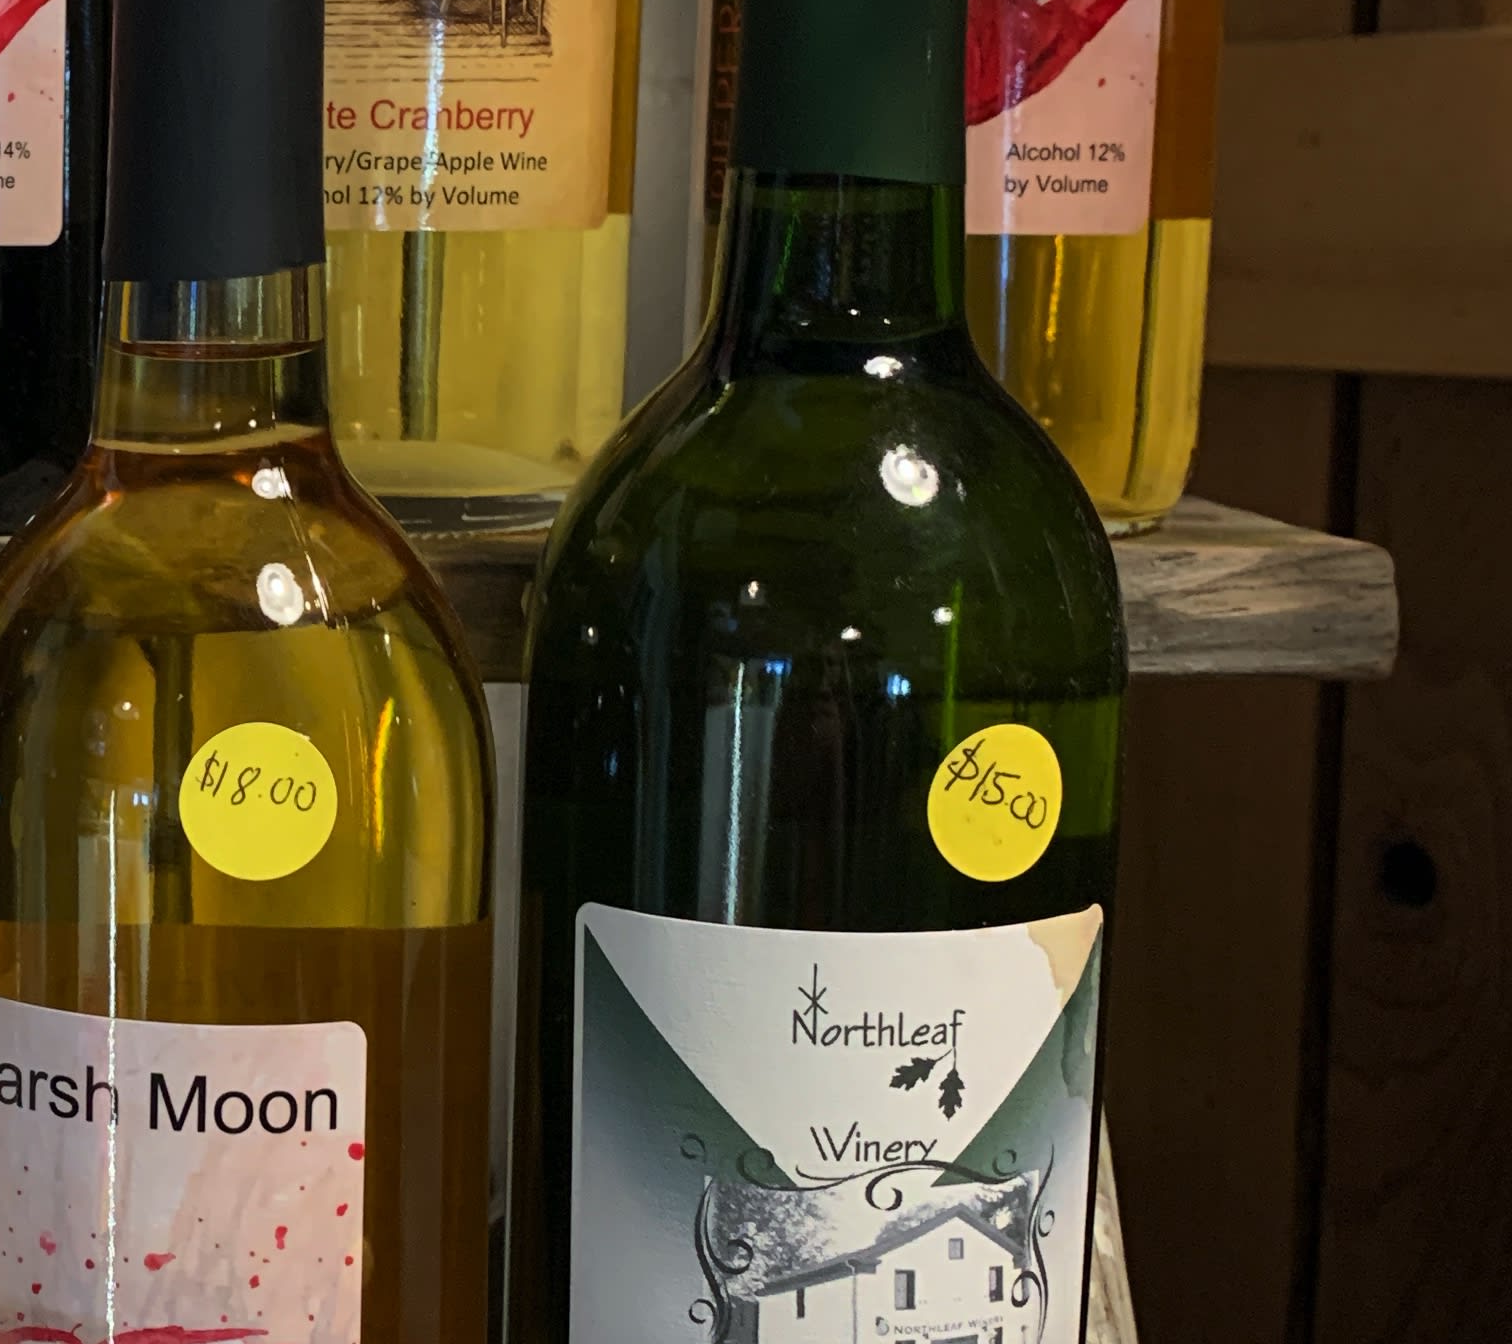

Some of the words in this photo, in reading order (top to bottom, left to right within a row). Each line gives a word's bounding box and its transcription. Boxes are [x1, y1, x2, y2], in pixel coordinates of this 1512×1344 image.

[370, 99, 535, 138] Cranberry
[324, 150, 494, 175] ry/Grape/Apple
[500, 151, 549, 172] Wine
[1006, 143, 1081, 162] Alcohol
[1089, 143, 1126, 163] 12%
[358, 186, 403, 206] 12%
[410, 186, 434, 208] by
[442, 187, 520, 207] Volume
[1004, 175, 1030, 197] by
[1036, 175, 1109, 194] Volume
[195, 749, 317, 812] $18.00
[944, 738, 1048, 829] $15.00
[792, 989, 966, 1047] Northleaf
[149, 1072, 338, 1135] Moon
[810, 1120, 938, 1163] Winery
[894, 1321, 963, 1336] NORTHLEAF
